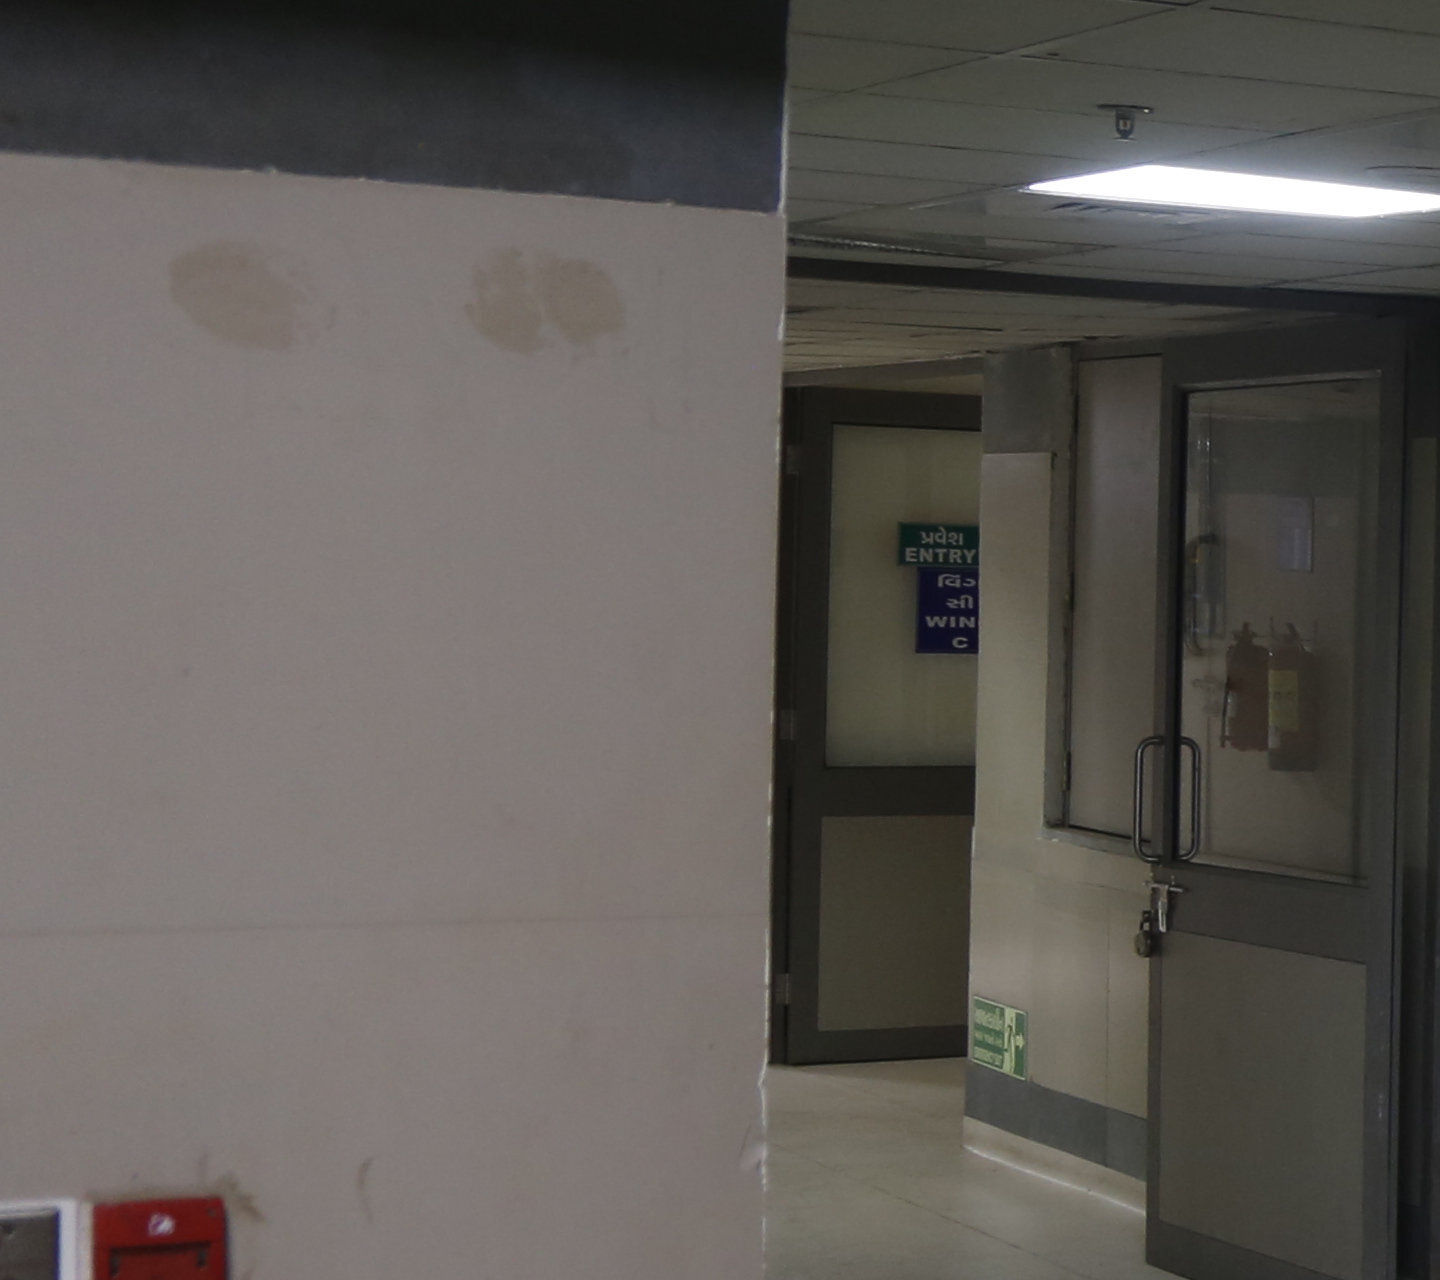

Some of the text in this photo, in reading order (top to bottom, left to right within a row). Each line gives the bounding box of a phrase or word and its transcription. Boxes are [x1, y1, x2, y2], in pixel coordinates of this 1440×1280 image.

[920, 526, 964, 545] પ્રવેશ
[905, 548, 976, 563] ENTRY
[946, 595, 974, 608] સી
[926, 616, 976, 628] WIN
[952, 637, 968, 648] C
